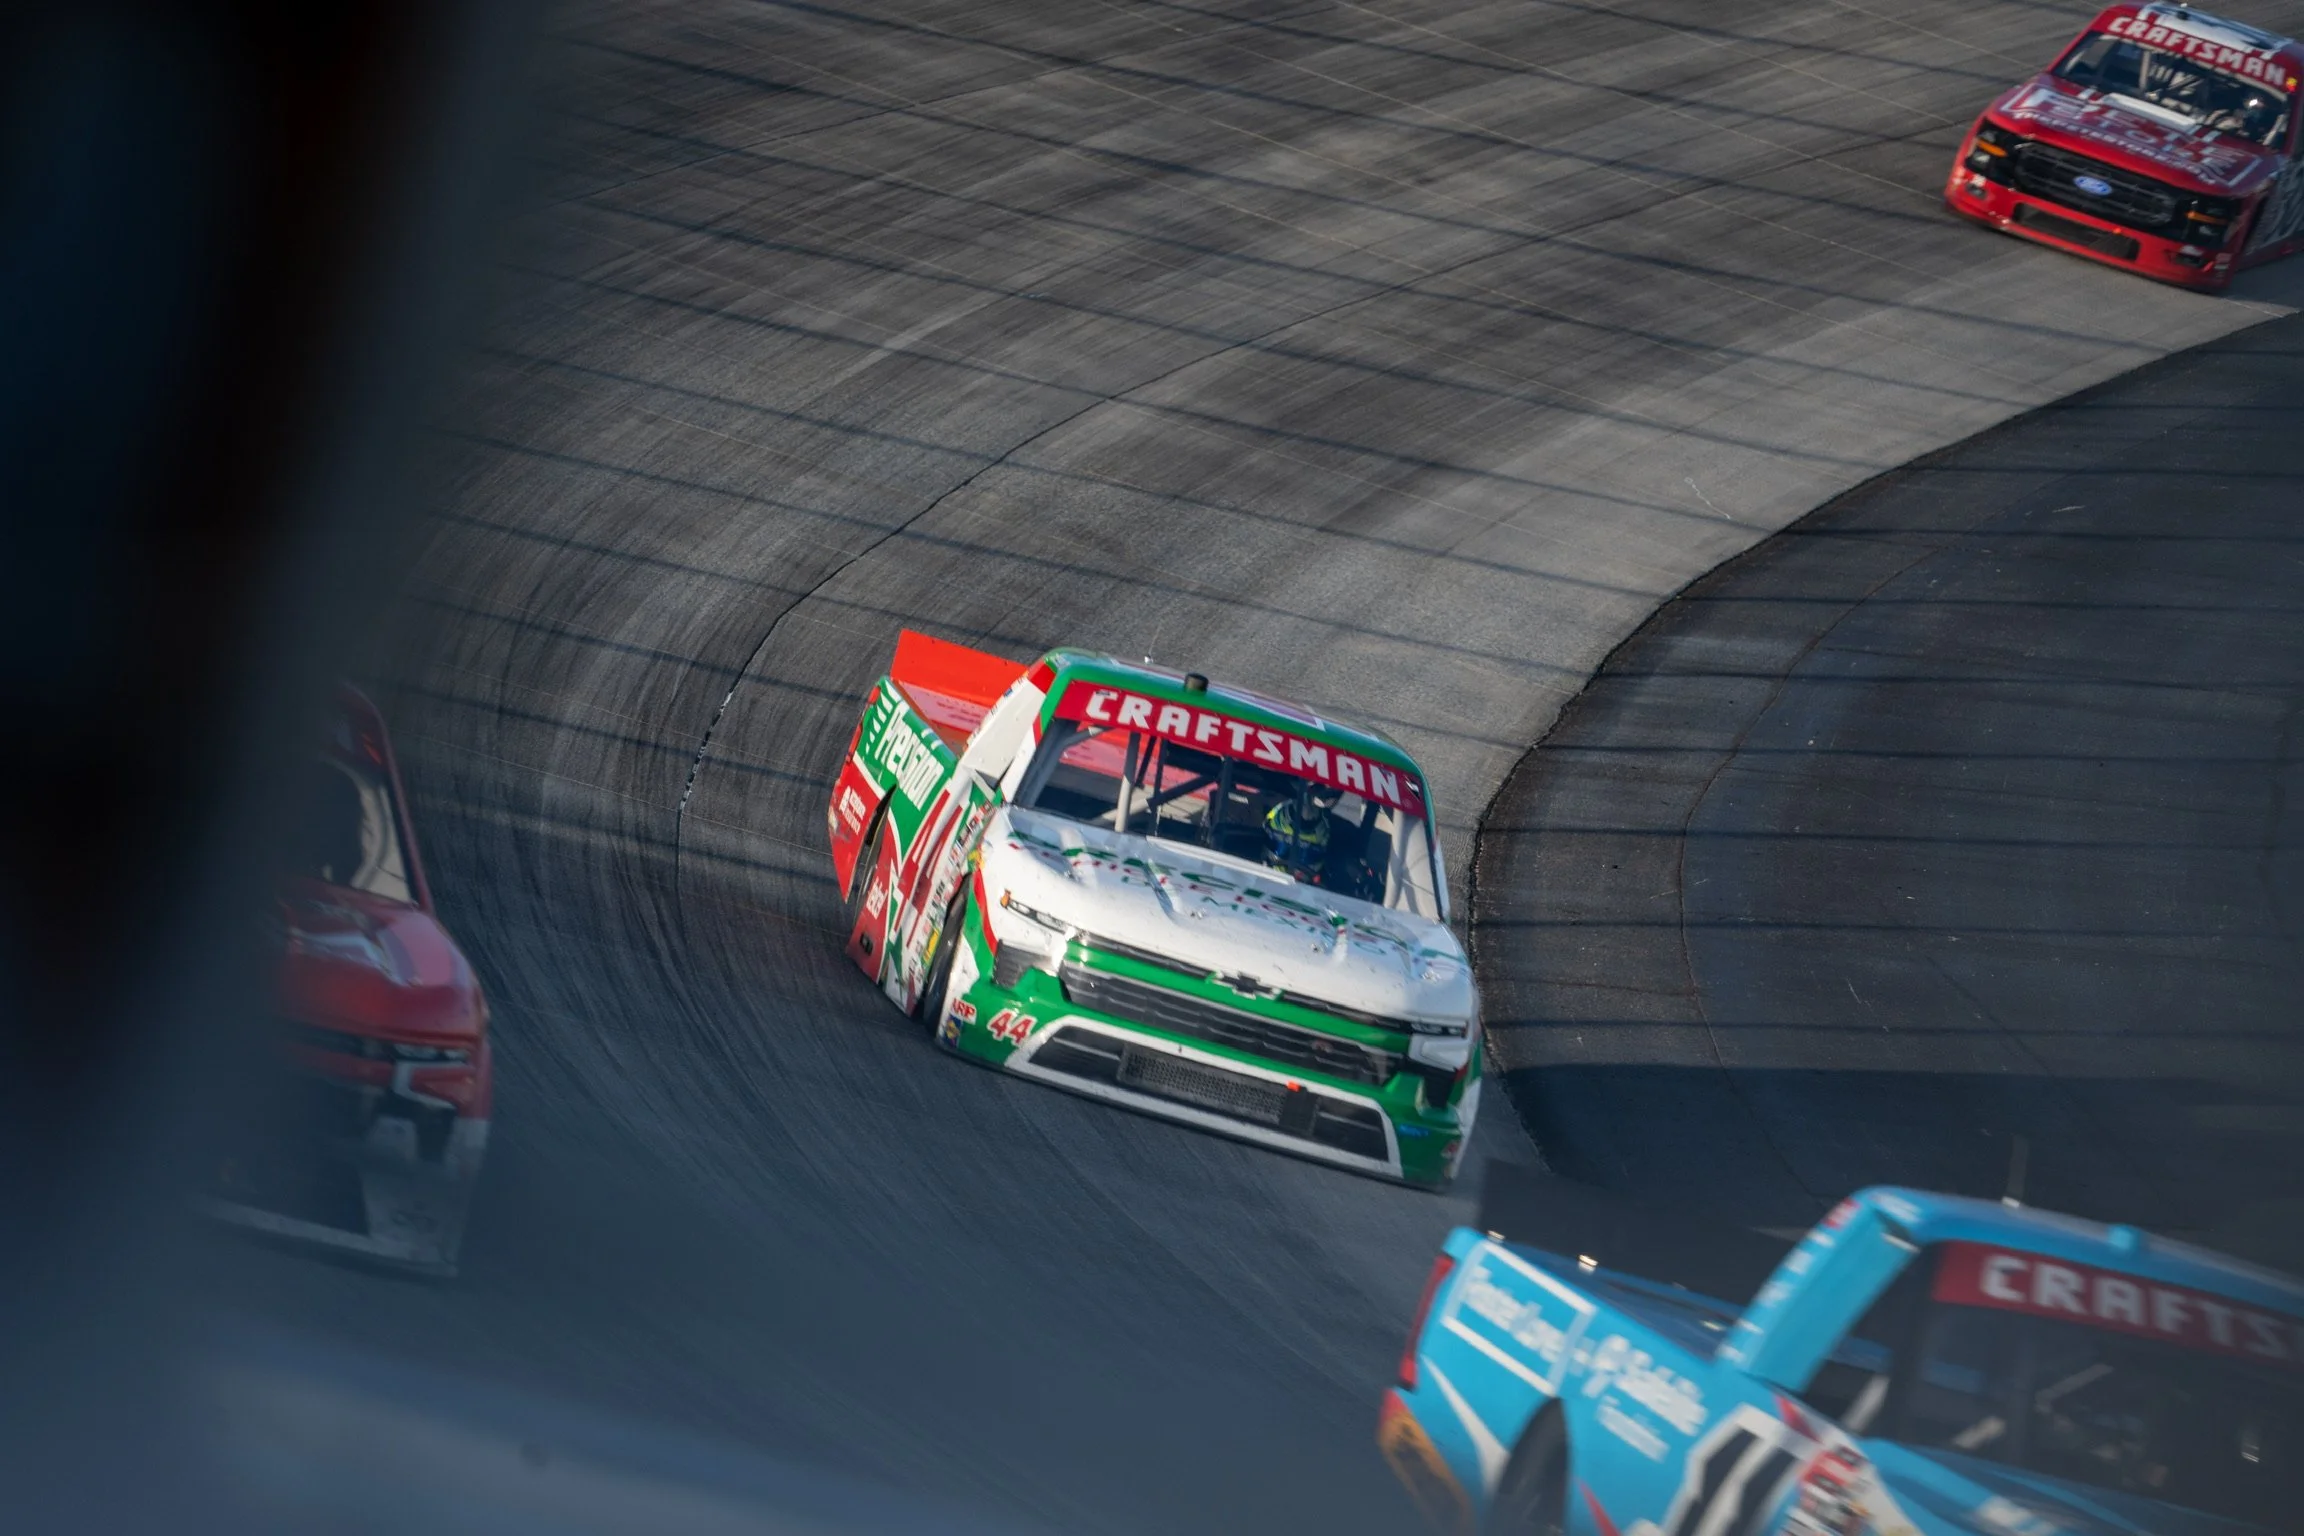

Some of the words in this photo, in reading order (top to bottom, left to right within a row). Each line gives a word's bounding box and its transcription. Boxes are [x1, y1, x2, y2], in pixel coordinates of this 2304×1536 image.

[2107, 16, 2287, 87] CRAFTSMAN
[1085, 689, 1400, 803] CRAFTSMAN
[987, 1010, 1037, 1046] 44
[1979, 1253, 2304, 1365] CRAFTS
